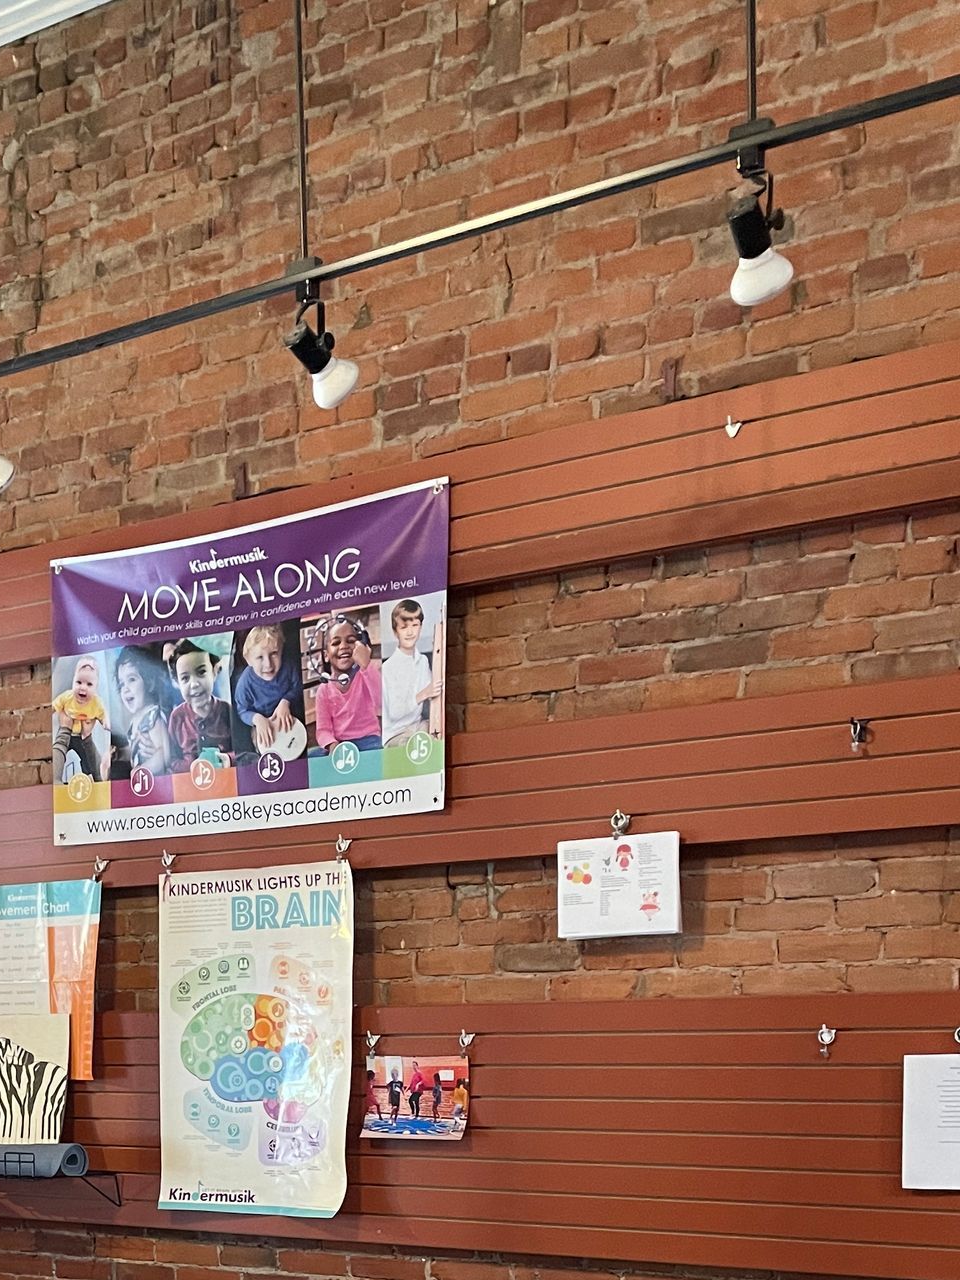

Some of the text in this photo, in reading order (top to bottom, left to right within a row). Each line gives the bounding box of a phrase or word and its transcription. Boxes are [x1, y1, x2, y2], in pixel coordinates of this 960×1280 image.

[189, 548, 267, 574] Kindermusik
[118, 547, 361, 622] MOVE ALONG
[77, 576, 419, 646] Watch your child gain new skills and grow in confidence with each new level.
[343, 749, 355, 766] 4
[417, 740, 428, 757] 5
[202, 767, 212, 784] 2
[270, 759, 281, 776] 3
[142, 774, 149, 790] 1
[87, 786, 412, 834] www.rosendales88keysacademy.com
[169, 871, 346, 897] KINDERMUSIK LIGHTS UP TH
[43, 901, 70, 914] Chart
[231, 889, 344, 931] BRAIN
[169, 1180, 256, 1203] Kindermusik
